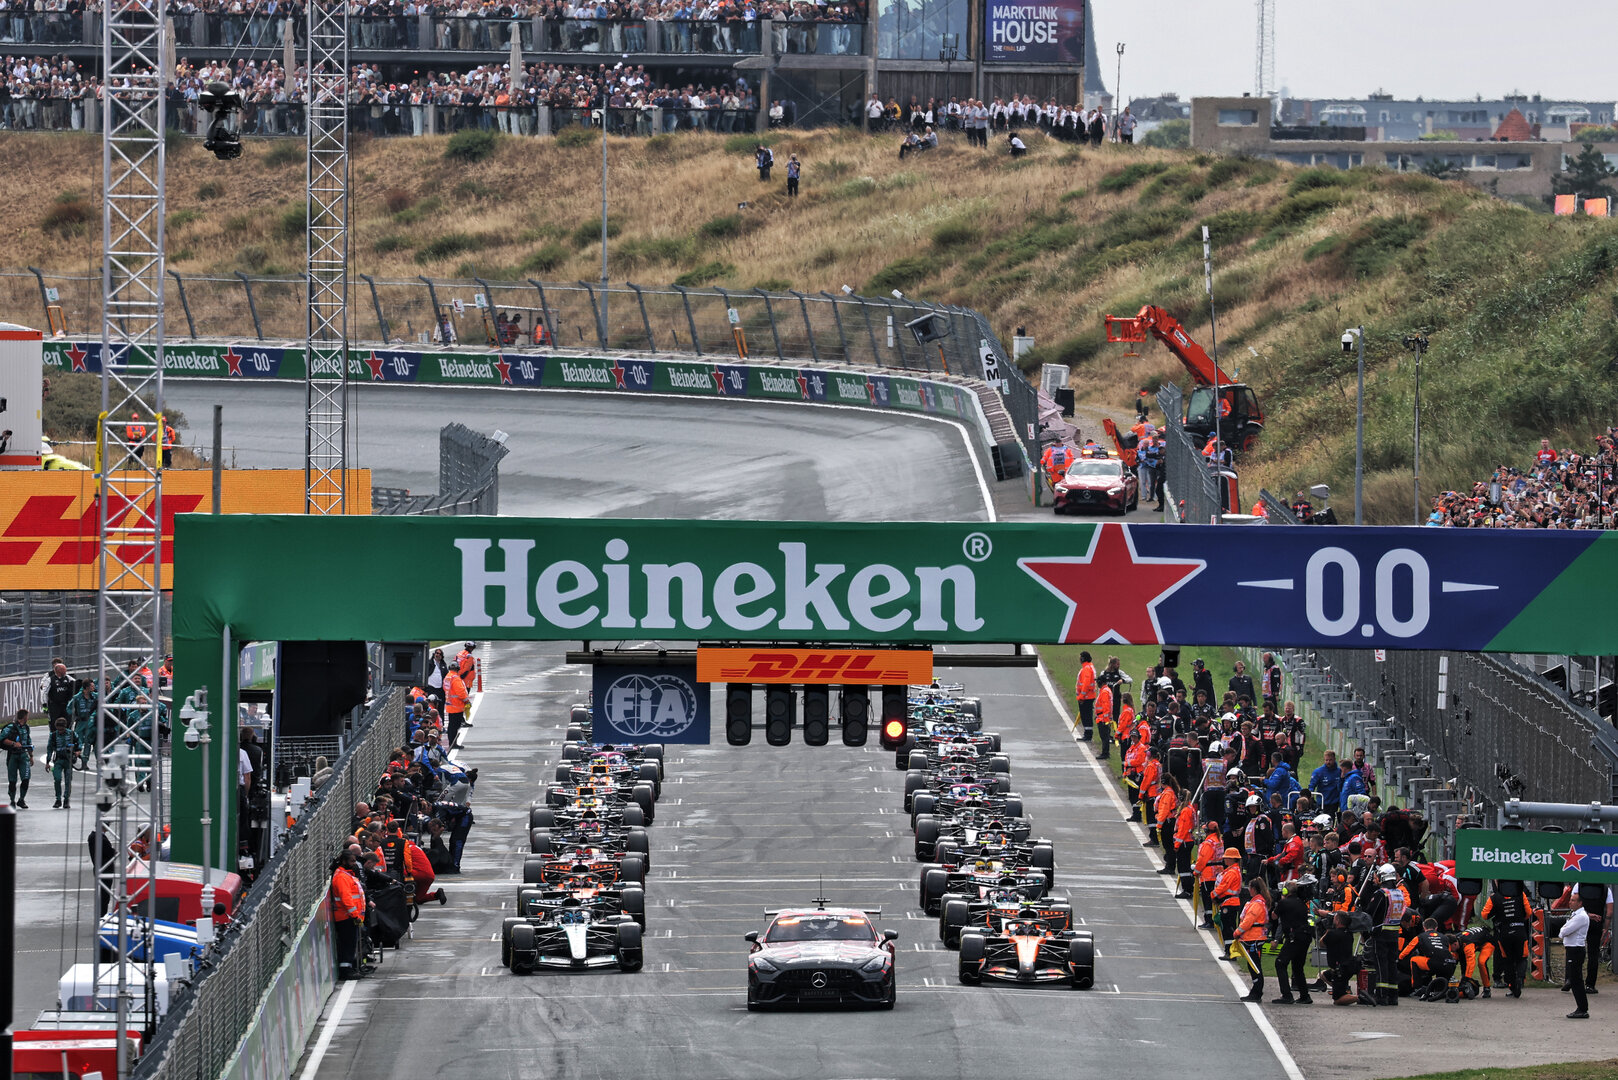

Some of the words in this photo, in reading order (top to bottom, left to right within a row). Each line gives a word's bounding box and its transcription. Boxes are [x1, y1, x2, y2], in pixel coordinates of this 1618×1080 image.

[992, 5, 1058, 20] MARKTLINK
[992, 20, 1058, 43] HOUSE
[253, 352, 270, 372] 0.0
[393, 357, 409, 376] 0.0
[438, 358, 494, 379] Heineken
[560, 362, 610, 383] Heineken
[667, 367, 712, 389] Heineken
[1305, 546, 1430, 639] 0.0
[746, 653, 883, 680] DHL
[2, 678, 44, 718] AIRWAY
